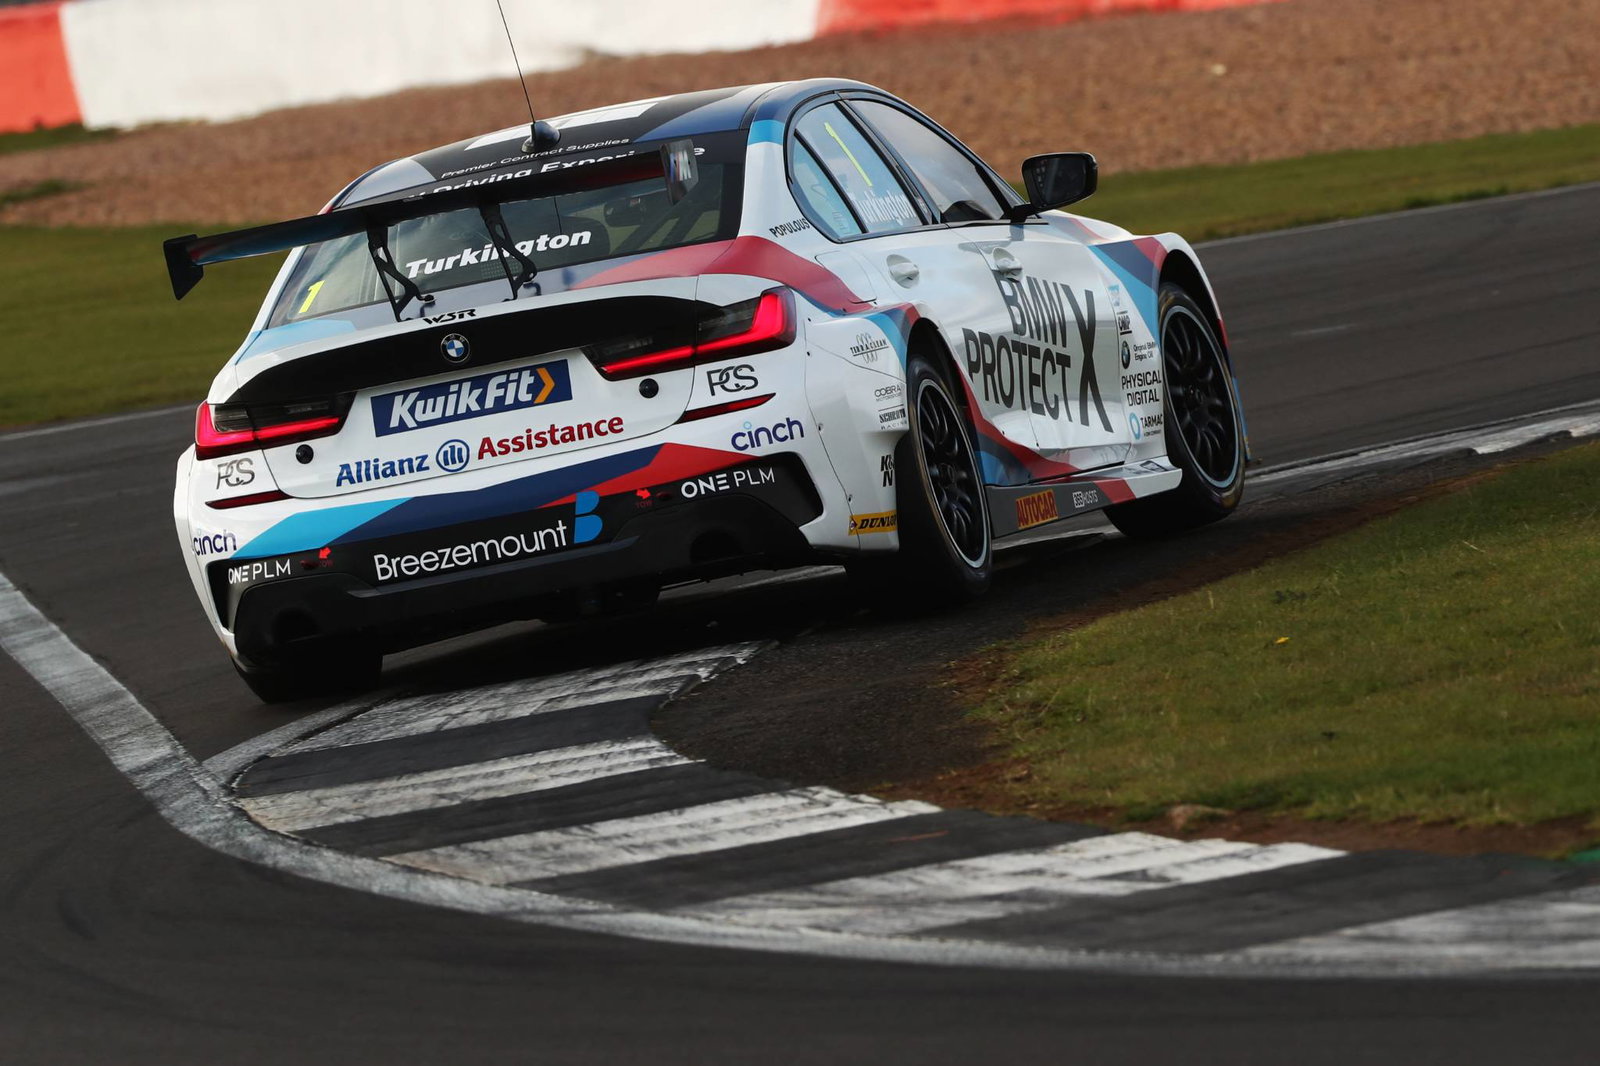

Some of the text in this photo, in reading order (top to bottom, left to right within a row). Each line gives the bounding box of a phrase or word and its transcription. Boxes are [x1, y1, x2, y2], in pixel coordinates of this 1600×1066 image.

[440, 137, 630, 179] Premier Contract Supplies
[768, 217, 811, 238] POPULOUS
[298, 280, 325, 314] 1
[991, 269, 1067, 348] BMW
[423, 308, 476, 324] WSR
[962, 327, 1073, 422] PROTECT
[1121, 370, 1162, 390] PHYSICAL
[874, 384, 902, 398] COBRA
[1127, 388, 1160, 407] DIGITAL
[731, 417, 804, 451] cinch
[336, 416, 624, 487] Allianz Assistance
[681, 467, 776, 498] ONE PLM
[1017, 492, 1057, 527] AUTOCAR
[193, 528, 237, 556] cinch
[373, 519, 568, 581] Breezemount
[228, 559, 291, 585] ONE PLM
